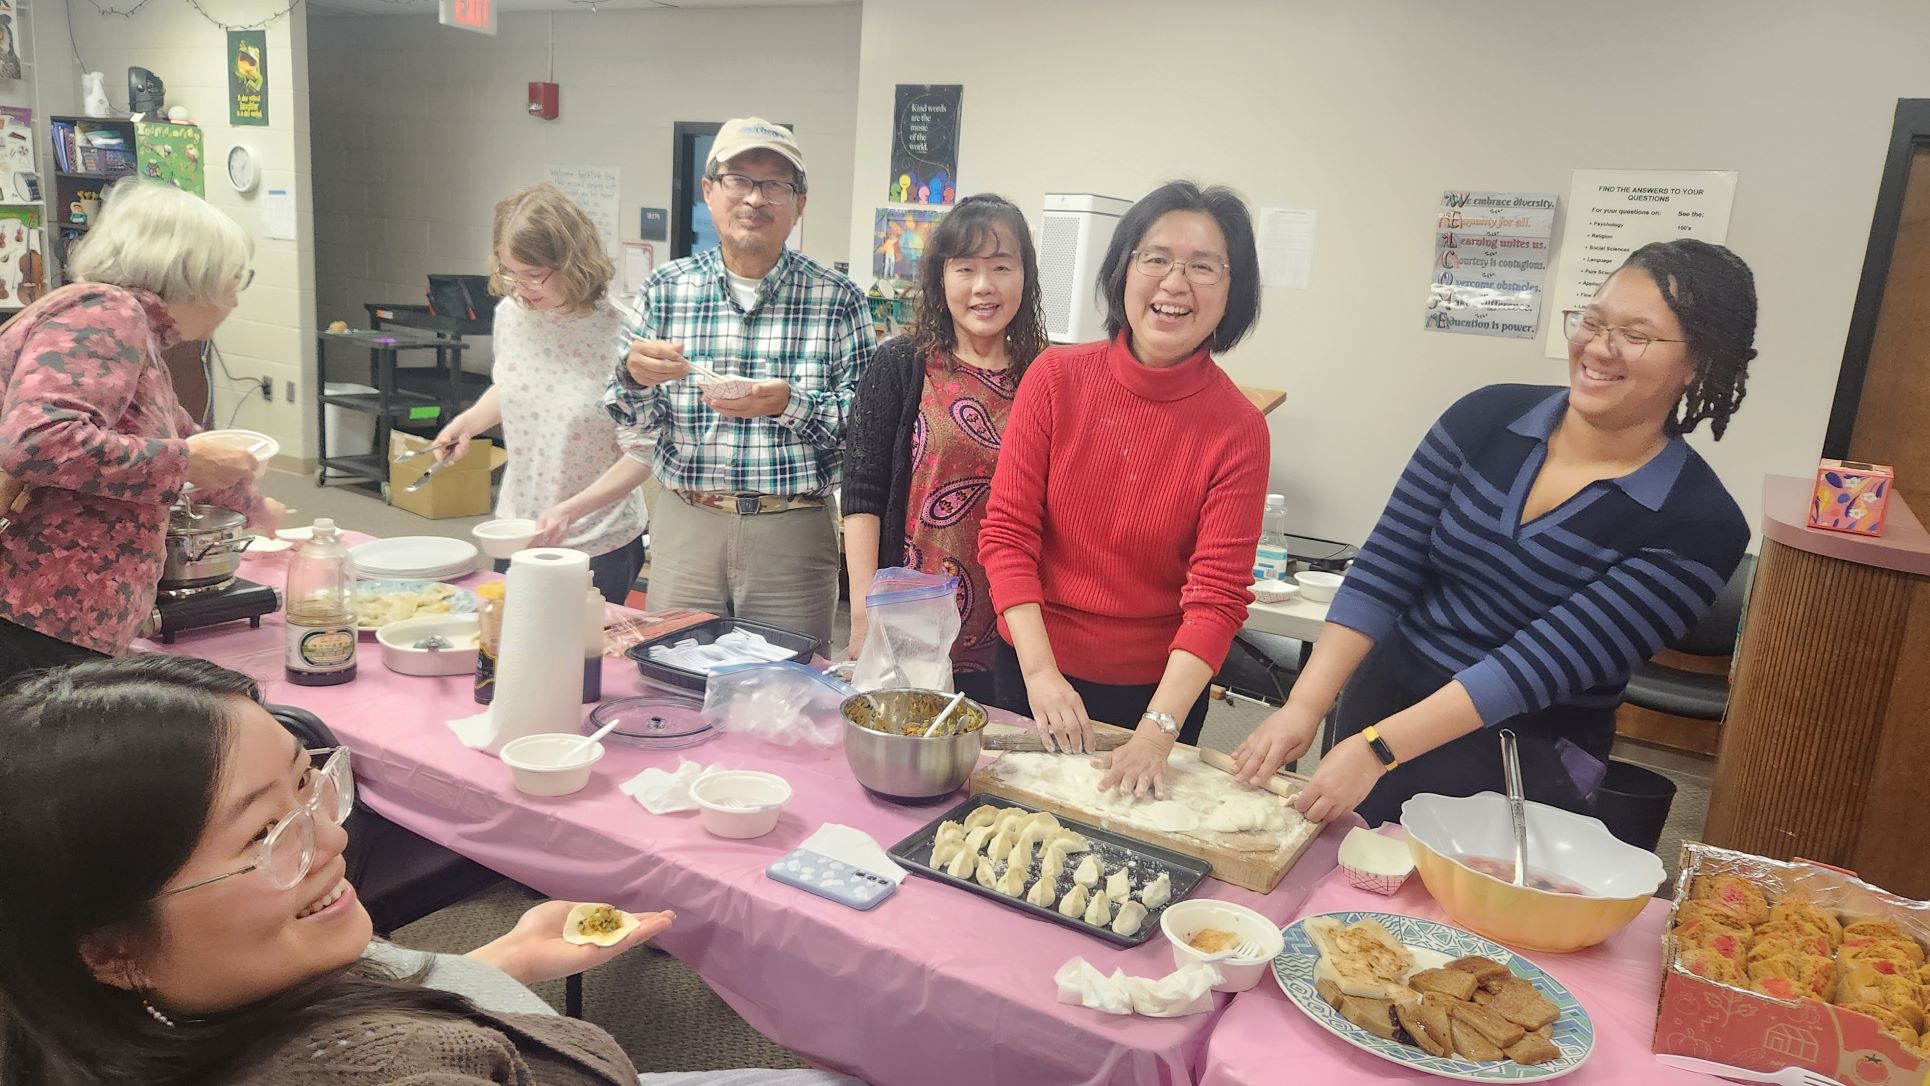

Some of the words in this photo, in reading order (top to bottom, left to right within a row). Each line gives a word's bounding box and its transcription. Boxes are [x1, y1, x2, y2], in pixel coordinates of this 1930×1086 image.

[912, 104, 928, 112] Kind
[928, 104, 946, 112] words
[921, 113, 931, 122] the
[911, 123, 928, 131] music
[909, 132, 917, 141] of
[917, 132, 927, 141] the
[909, 142, 928, 150] world.
[1598, 185, 1615, 193] FIND
[1616, 186, 1631, 194] THE
[1631, 187, 1669, 195] ANSWERS
[1682, 188, 1704, 196] YOUR
[1444, 192, 1472, 208] We
[1473, 196, 1511, 206] embrace
[1513, 197, 1555, 209] diversity.
[1627, 194, 1670, 203] QUESTIONS
[1618, 208, 1650, 216] questions
[1499, 216, 1514, 229] for
[1515, 216, 1531, 228] all.
[1593, 221, 1624, 229] Psychology
[1442, 232, 1498, 250] Learning
[1500, 238, 1530, 249] unites
[1532, 241, 1547, 249] us.
[1442, 250, 1489, 269] Courtesy
[1490, 257, 1497, 266] is
[1498, 258, 1546, 272] contagious.
[1587, 256, 1613, 264] Language
[1438, 270, 1495, 289] Overcome
[1496, 278, 1542, 293] obstacles.
[1437, 311, 1490, 329] Education
[1491, 319, 1499, 329] is
[1501, 321, 1535, 333] power.
